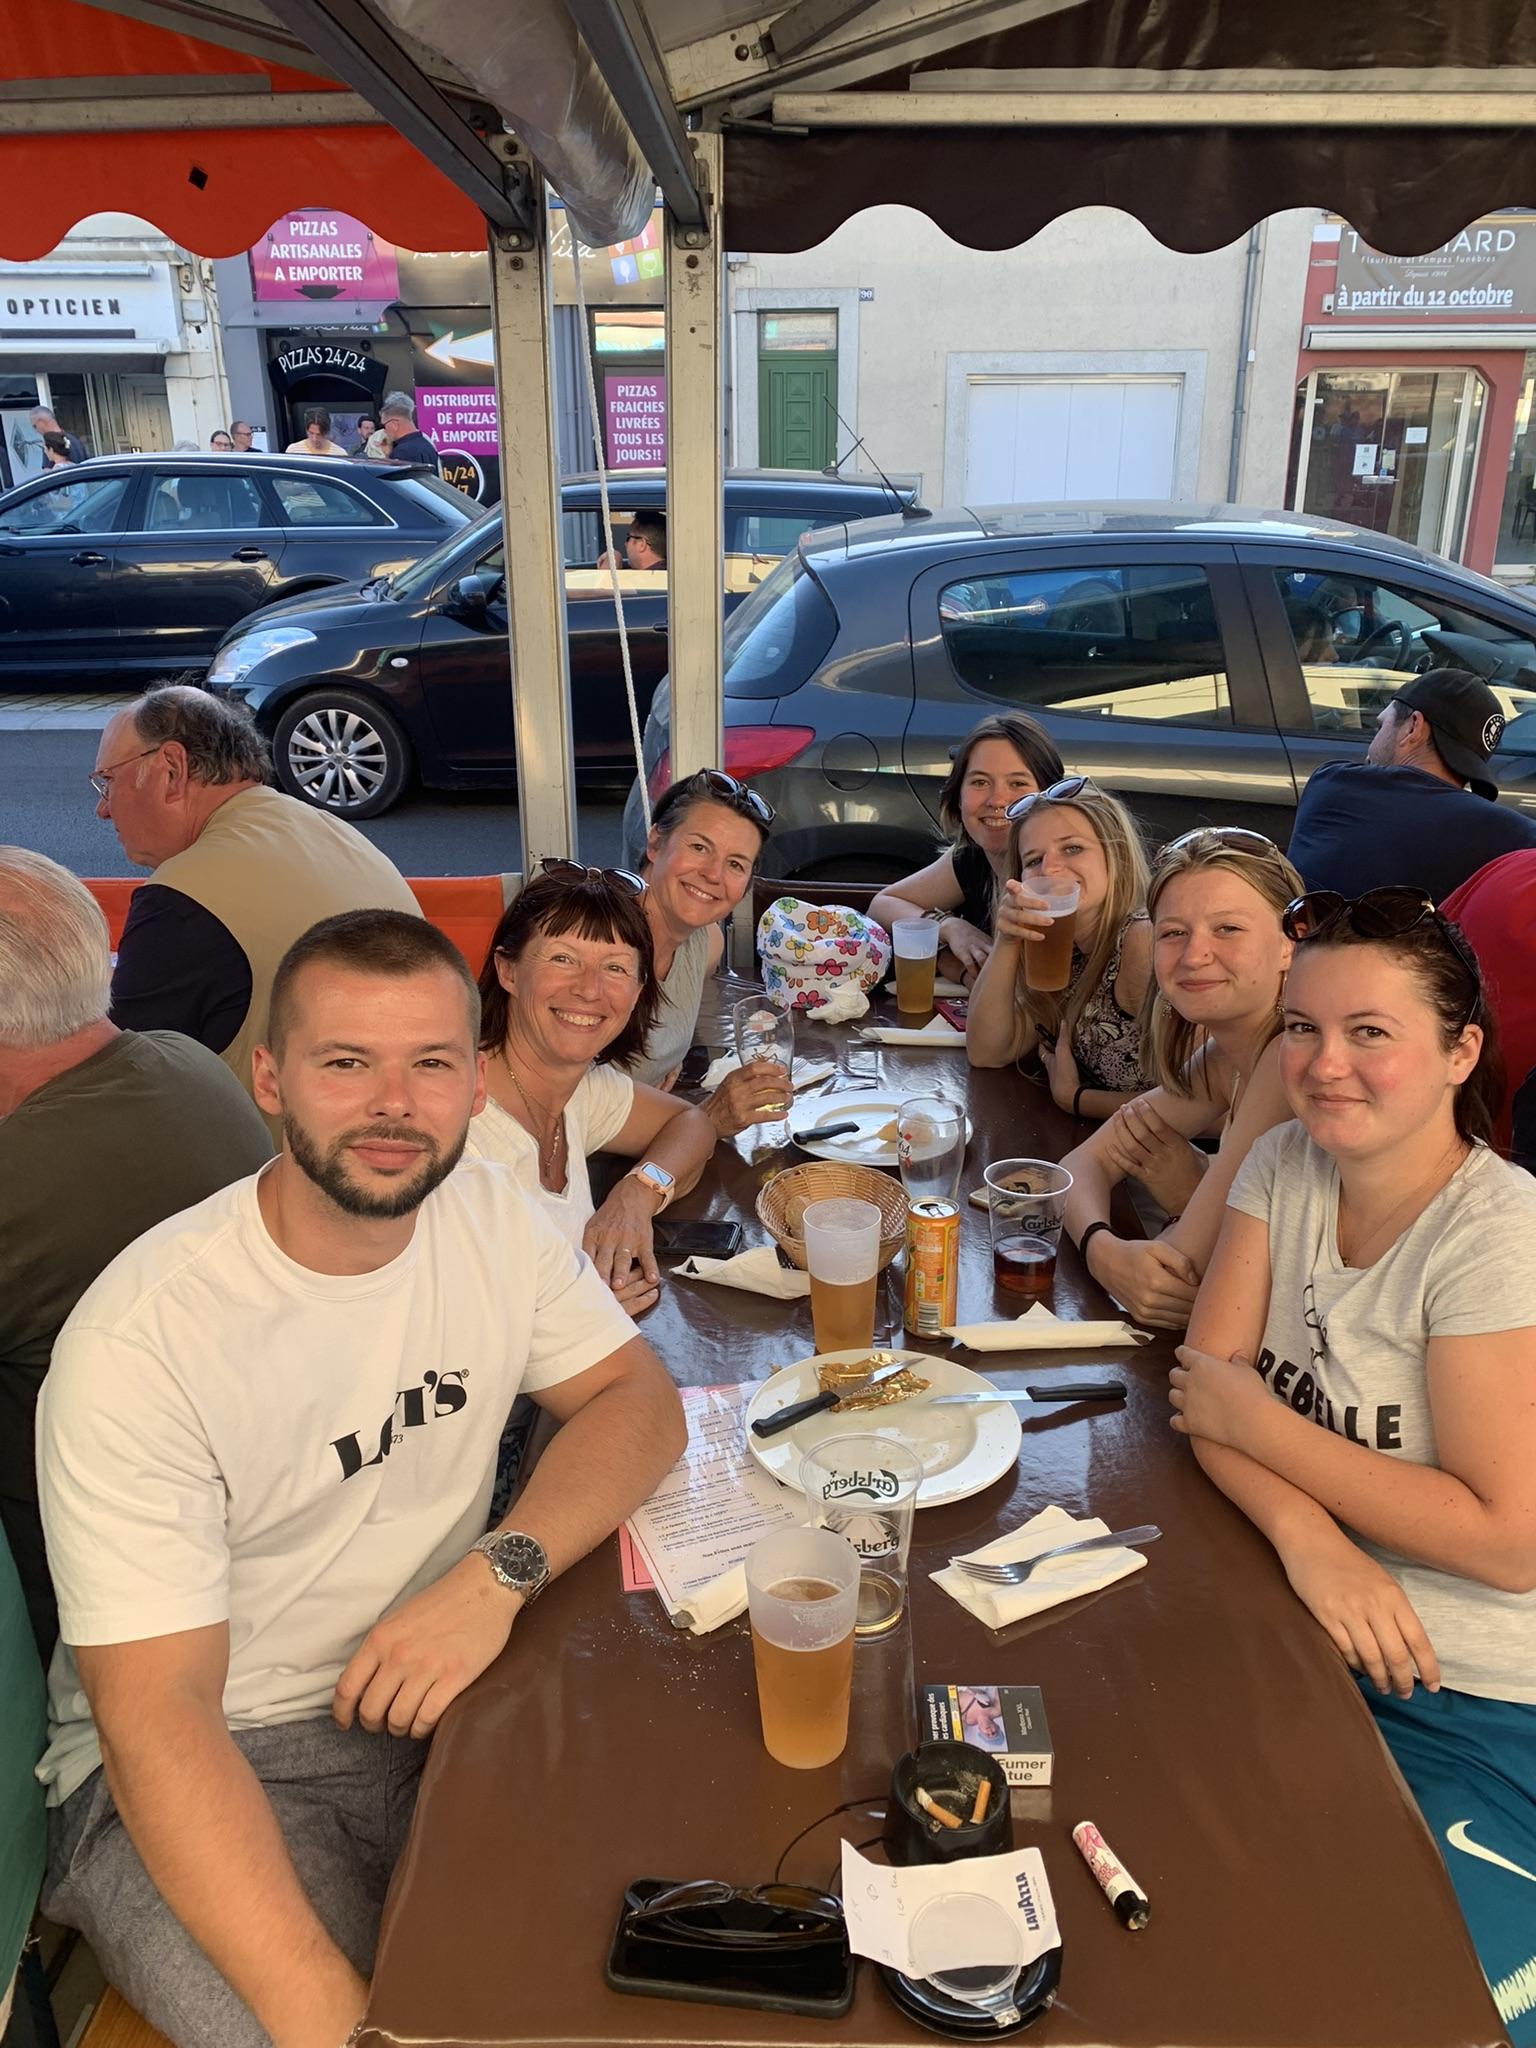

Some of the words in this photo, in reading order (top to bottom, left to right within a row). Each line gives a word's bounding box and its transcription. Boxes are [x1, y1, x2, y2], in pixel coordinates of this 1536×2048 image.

[290, 221, 338, 236] PIZZAS
[270, 244, 362, 259] ARTISANALES
[274, 266, 286, 281] A
[288, 266, 363, 281] EMPORTER
[1338, 284, 1348, 306] à
[1352, 285, 1401, 310] partir
[1403, 284, 1424, 306] du
[1428, 290, 1446, 306] 12
[1449, 283, 1513, 305] octobre
[6, 298, 121, 316] OPTICIEN
[278, 347, 323, 373] PIZZAS
[324, 347, 367, 372] 24/24
[617, 385, 657, 397] PIZZAS
[610, 401, 665, 413] FRAICHES
[437, 412, 452, 425] DE
[456, 412, 497, 425] PIZZAS
[615, 414, 660, 429] LIVRÉES
[431, 427, 440, 442] À
[442, 430, 499, 443] EMPORTE
[612, 433, 642, 445] TOUS
[645, 433, 665, 445] LES
[615, 449, 661, 463] JOURS!!
[926, 1693, 935, 1703] des
[998, 1758, 1047, 1770] Fumer
[1007, 1770, 1033, 1781] tue
[1016, 1872, 1040, 1931] LAVAZZA
